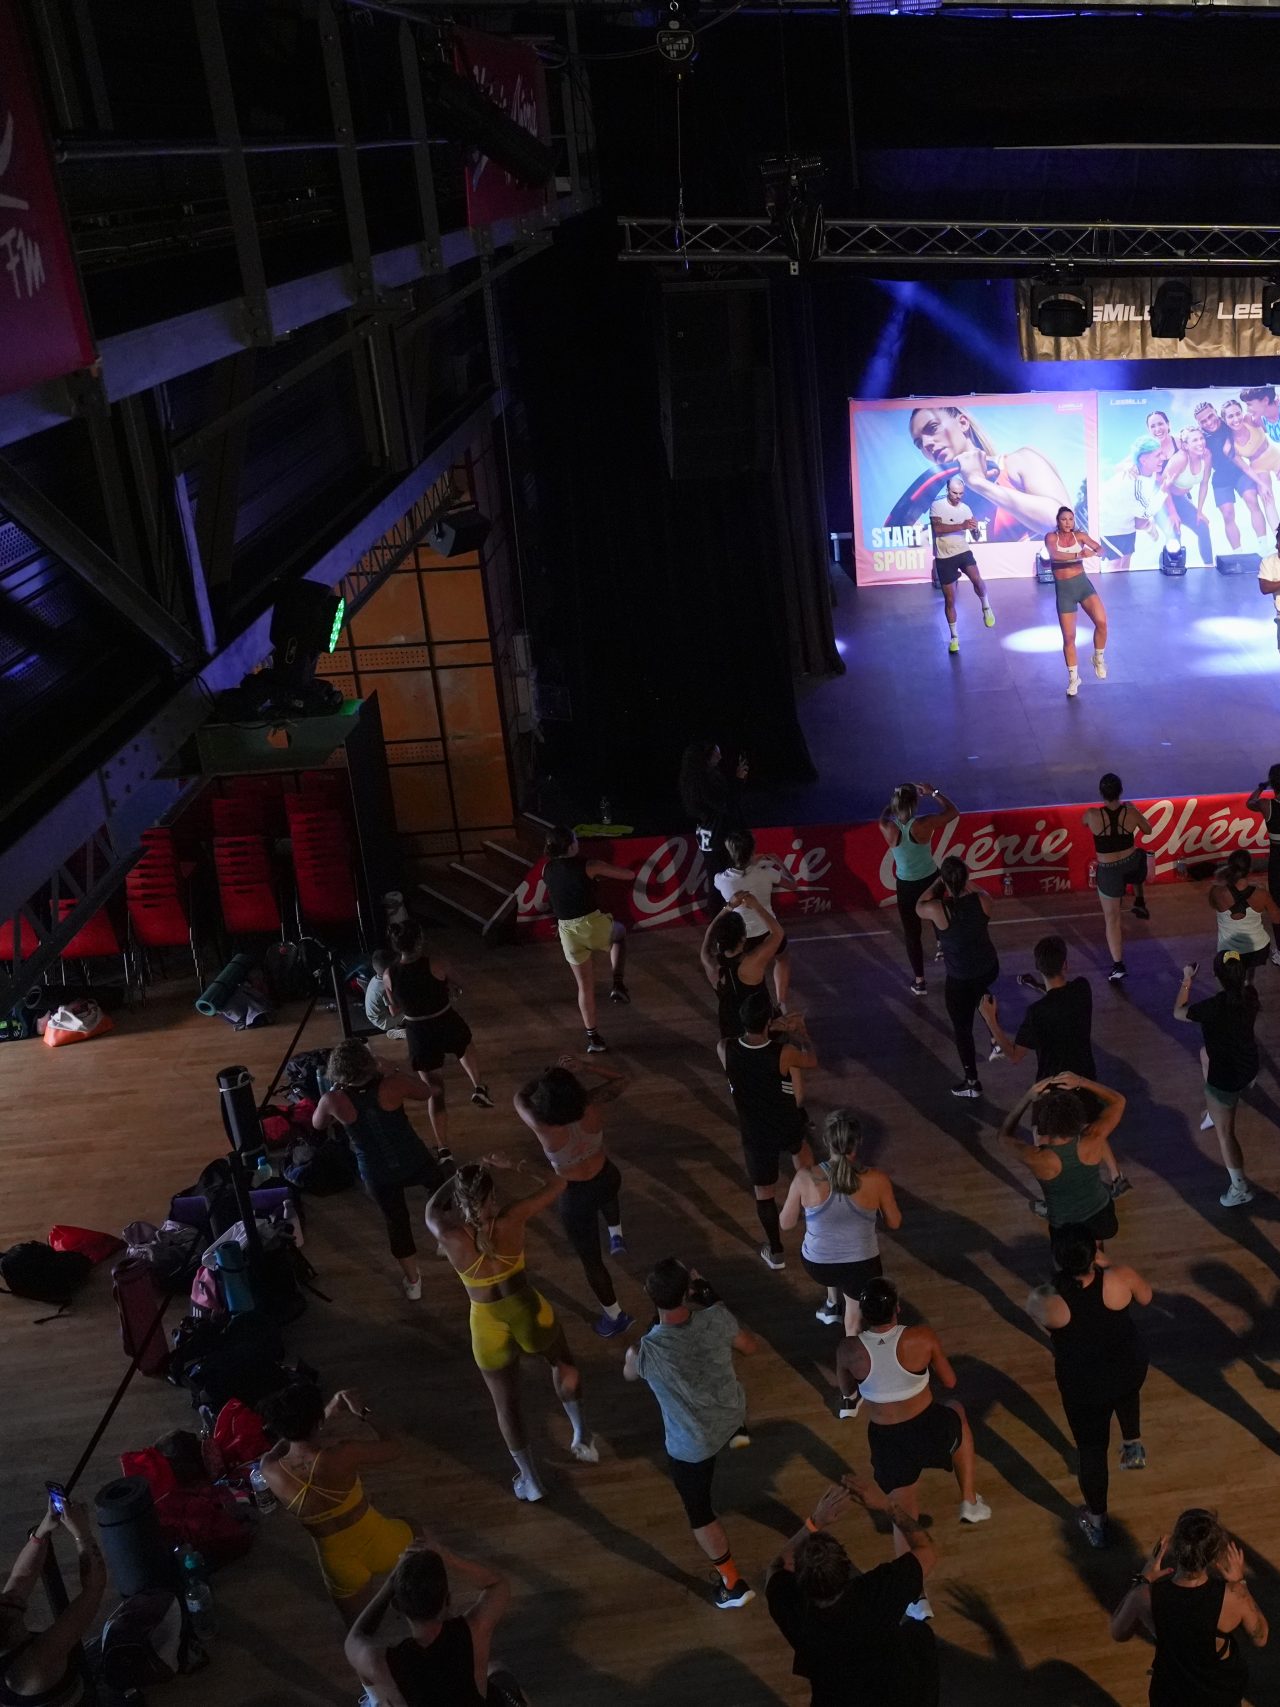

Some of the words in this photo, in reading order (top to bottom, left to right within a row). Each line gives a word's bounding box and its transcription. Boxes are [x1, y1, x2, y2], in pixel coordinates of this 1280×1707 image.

[871, 524, 926, 549] START
[873, 549, 926, 572] SPORT
[1040, 876, 1072, 893] FM
[799, 897, 832, 915] FM
